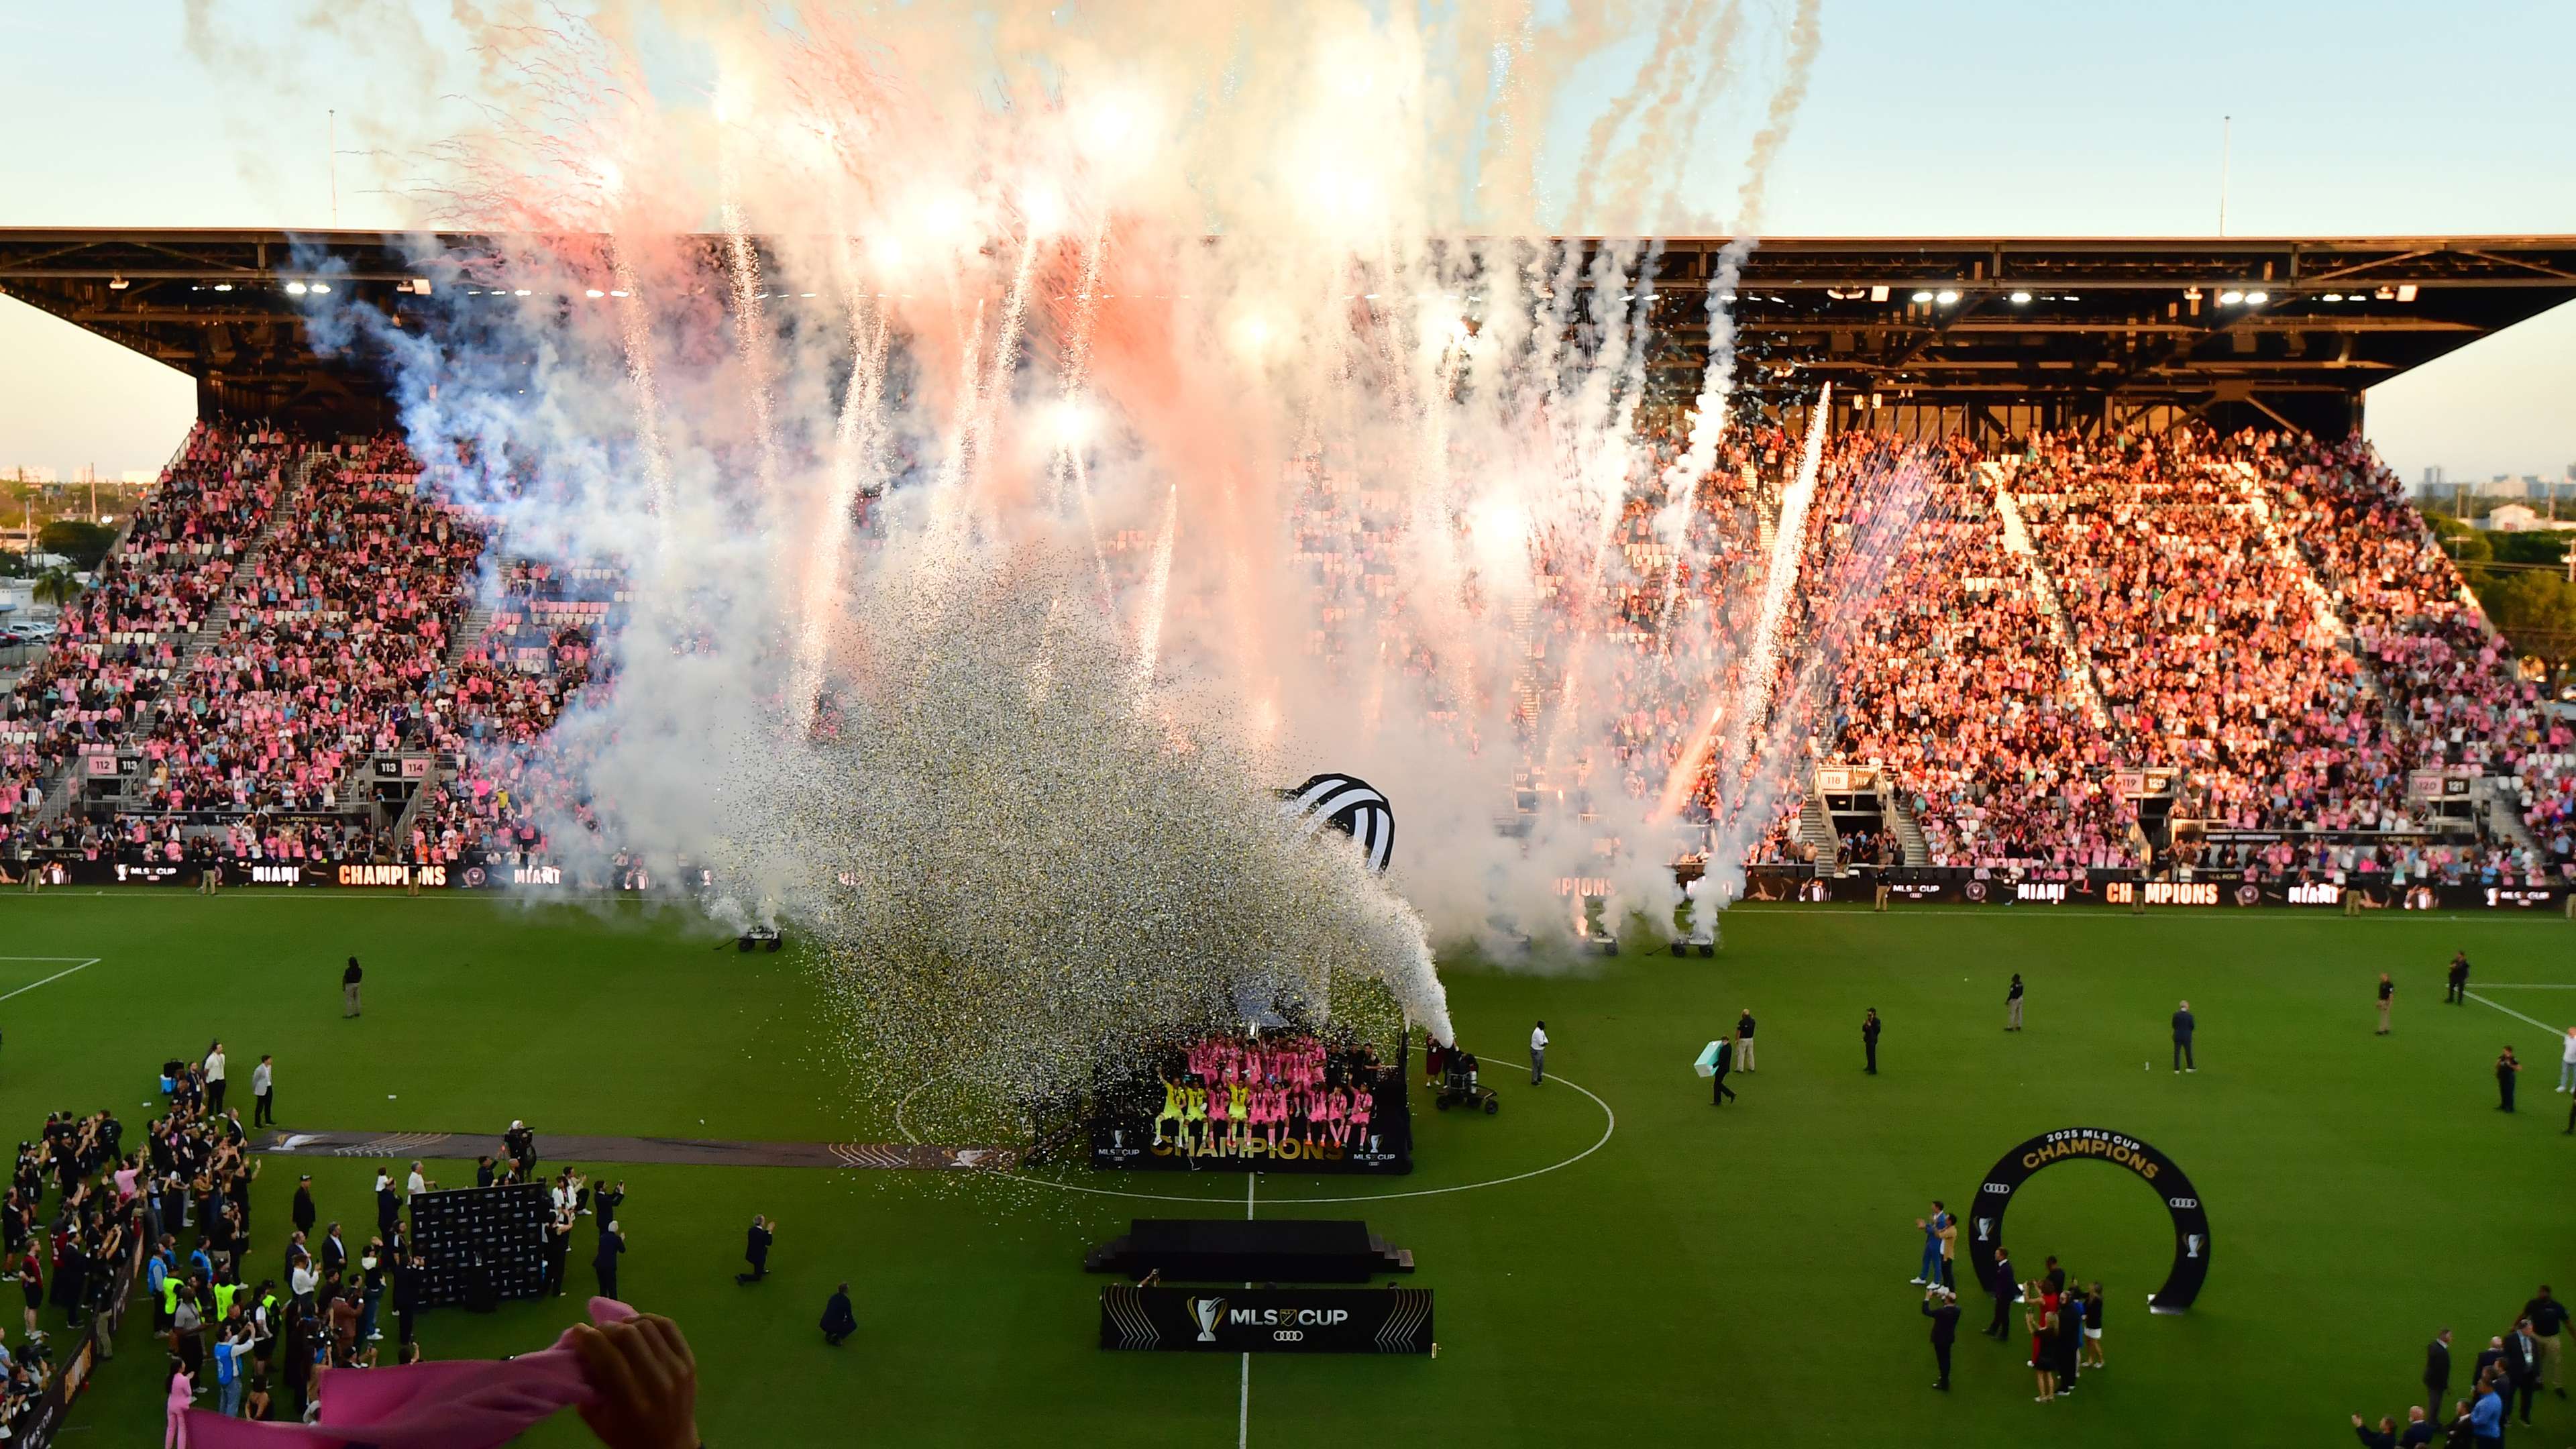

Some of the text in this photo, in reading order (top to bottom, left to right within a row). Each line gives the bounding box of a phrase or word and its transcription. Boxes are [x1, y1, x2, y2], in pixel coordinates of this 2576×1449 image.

[95, 760, 111, 770] 112
[121, 760, 138, 771] 113
[380, 763, 397, 773] 113
[408, 763, 424, 773] 114
[1515, 773, 1529, 782] 117
[1827, 776, 1841, 785] 118
[2122, 778, 2137, 788] 119
[2148, 778, 2167, 789] 120
[2418, 780, 2436, 790] 120
[2448, 780, 2465, 792] 121
[130, 867, 177, 875] MLS CUP
[253, 866, 299, 882] MIAMI
[339, 865, 446, 885] CHAMPINS
[2017, 883, 2065, 900] MIAMI
[2106, 882, 2218, 904] CHMPIONS
[2047, 1129, 2141, 1151] 2025 MLS CUP
[1098, 1148, 1140, 1157] MLS CUP
[1354, 1153, 1395, 1161] MLS CUP
[2022, 1138, 2159, 1179] CHAMPIONS
[1230, 1309, 1348, 1326] MLS CUP
